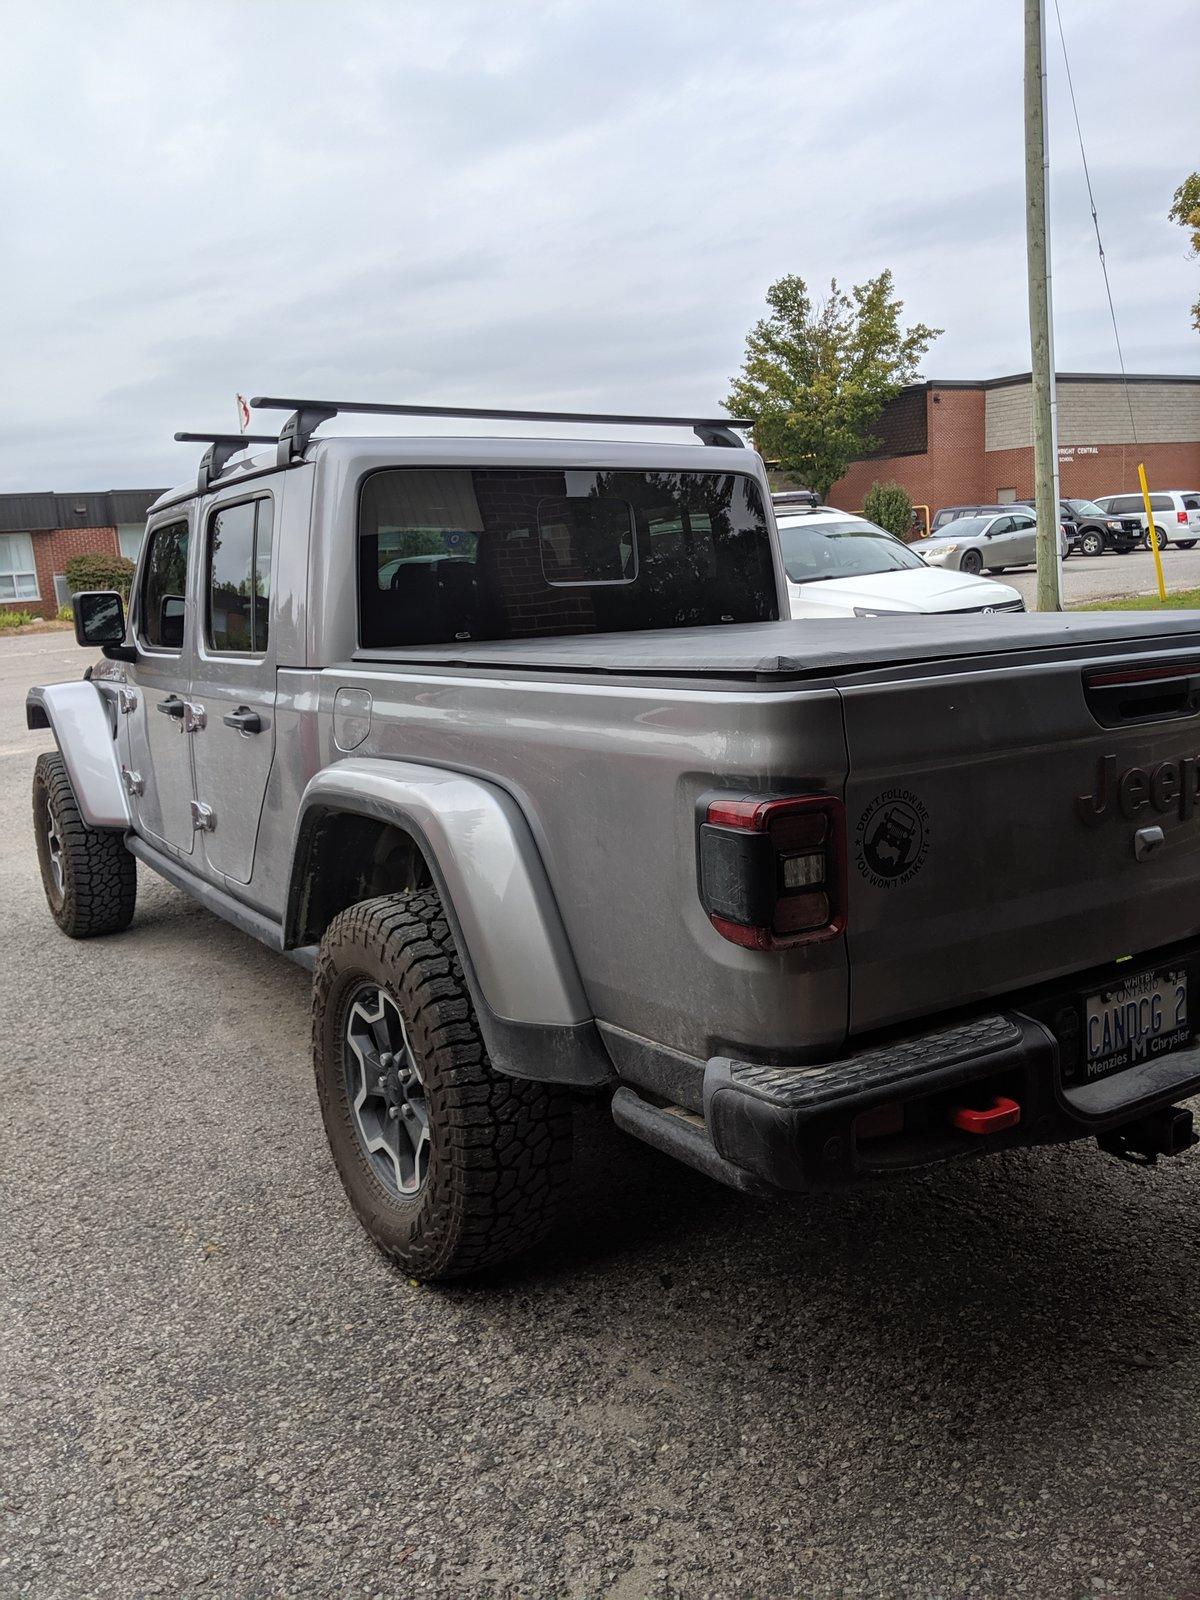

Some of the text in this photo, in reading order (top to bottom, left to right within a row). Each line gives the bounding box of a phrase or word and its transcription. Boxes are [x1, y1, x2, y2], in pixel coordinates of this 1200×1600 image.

[856, 788, 930, 831] DON'T FOLLOW ME
[855, 852, 870, 878] YOU
[900, 855, 925, 885] MAKE
[922, 840, 930, 853] IT
[1116, 978, 1159, 1003] ONTARIO
[1123, 971, 1155, 989] WHITBY
[1088, 984, 1186, 1056] CANDCG 2
[1087, 1029, 1190, 1077] Menzies M Chrysler
